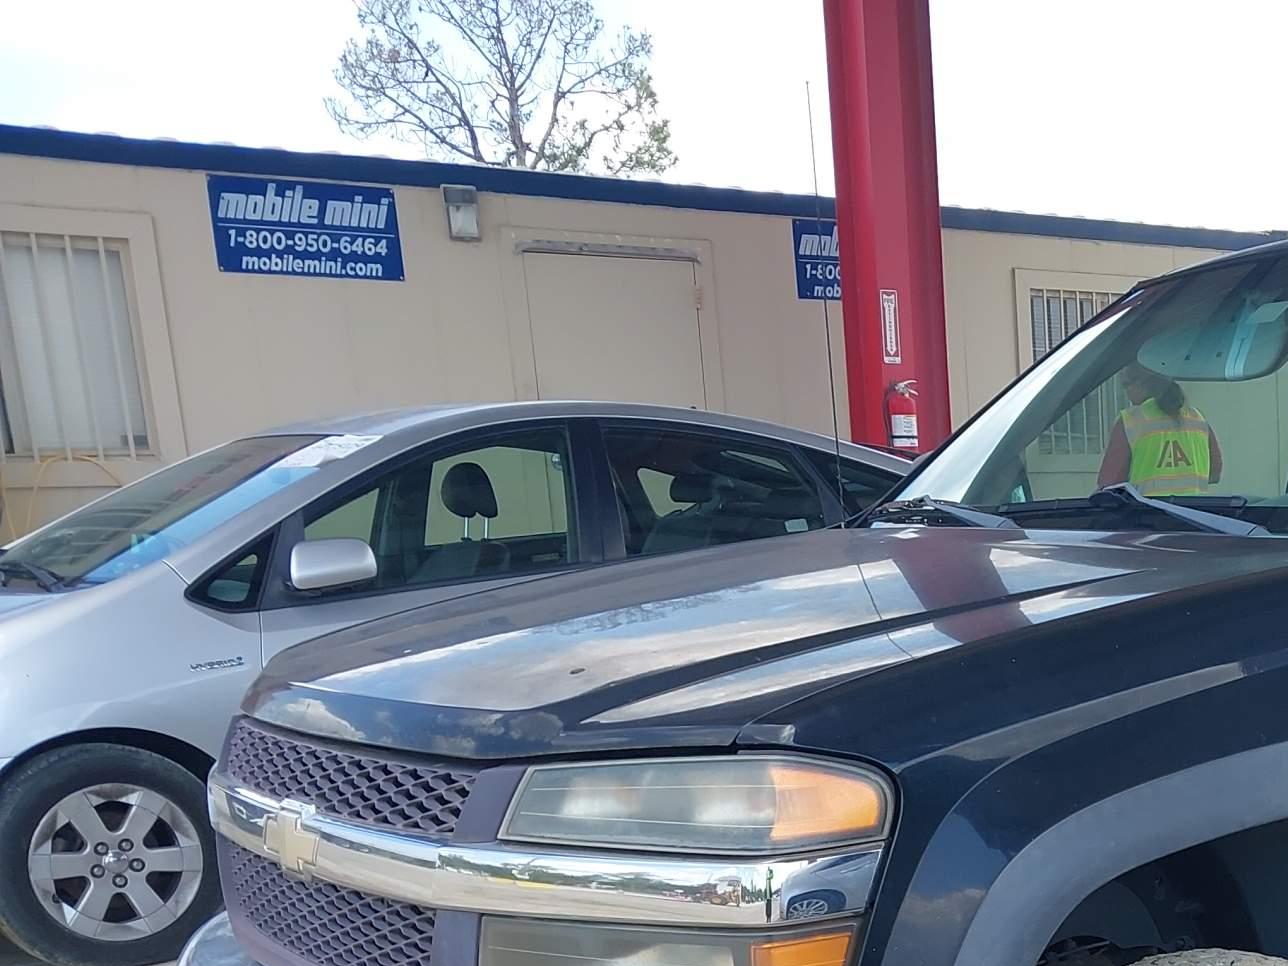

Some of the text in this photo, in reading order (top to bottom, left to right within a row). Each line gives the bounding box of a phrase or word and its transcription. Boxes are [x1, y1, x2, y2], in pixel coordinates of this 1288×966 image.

[217, 182, 390, 229] mobile mini
[227, 228, 389, 257] 1-800-950-6464
[241, 253, 384, 277] mobilemini.com
